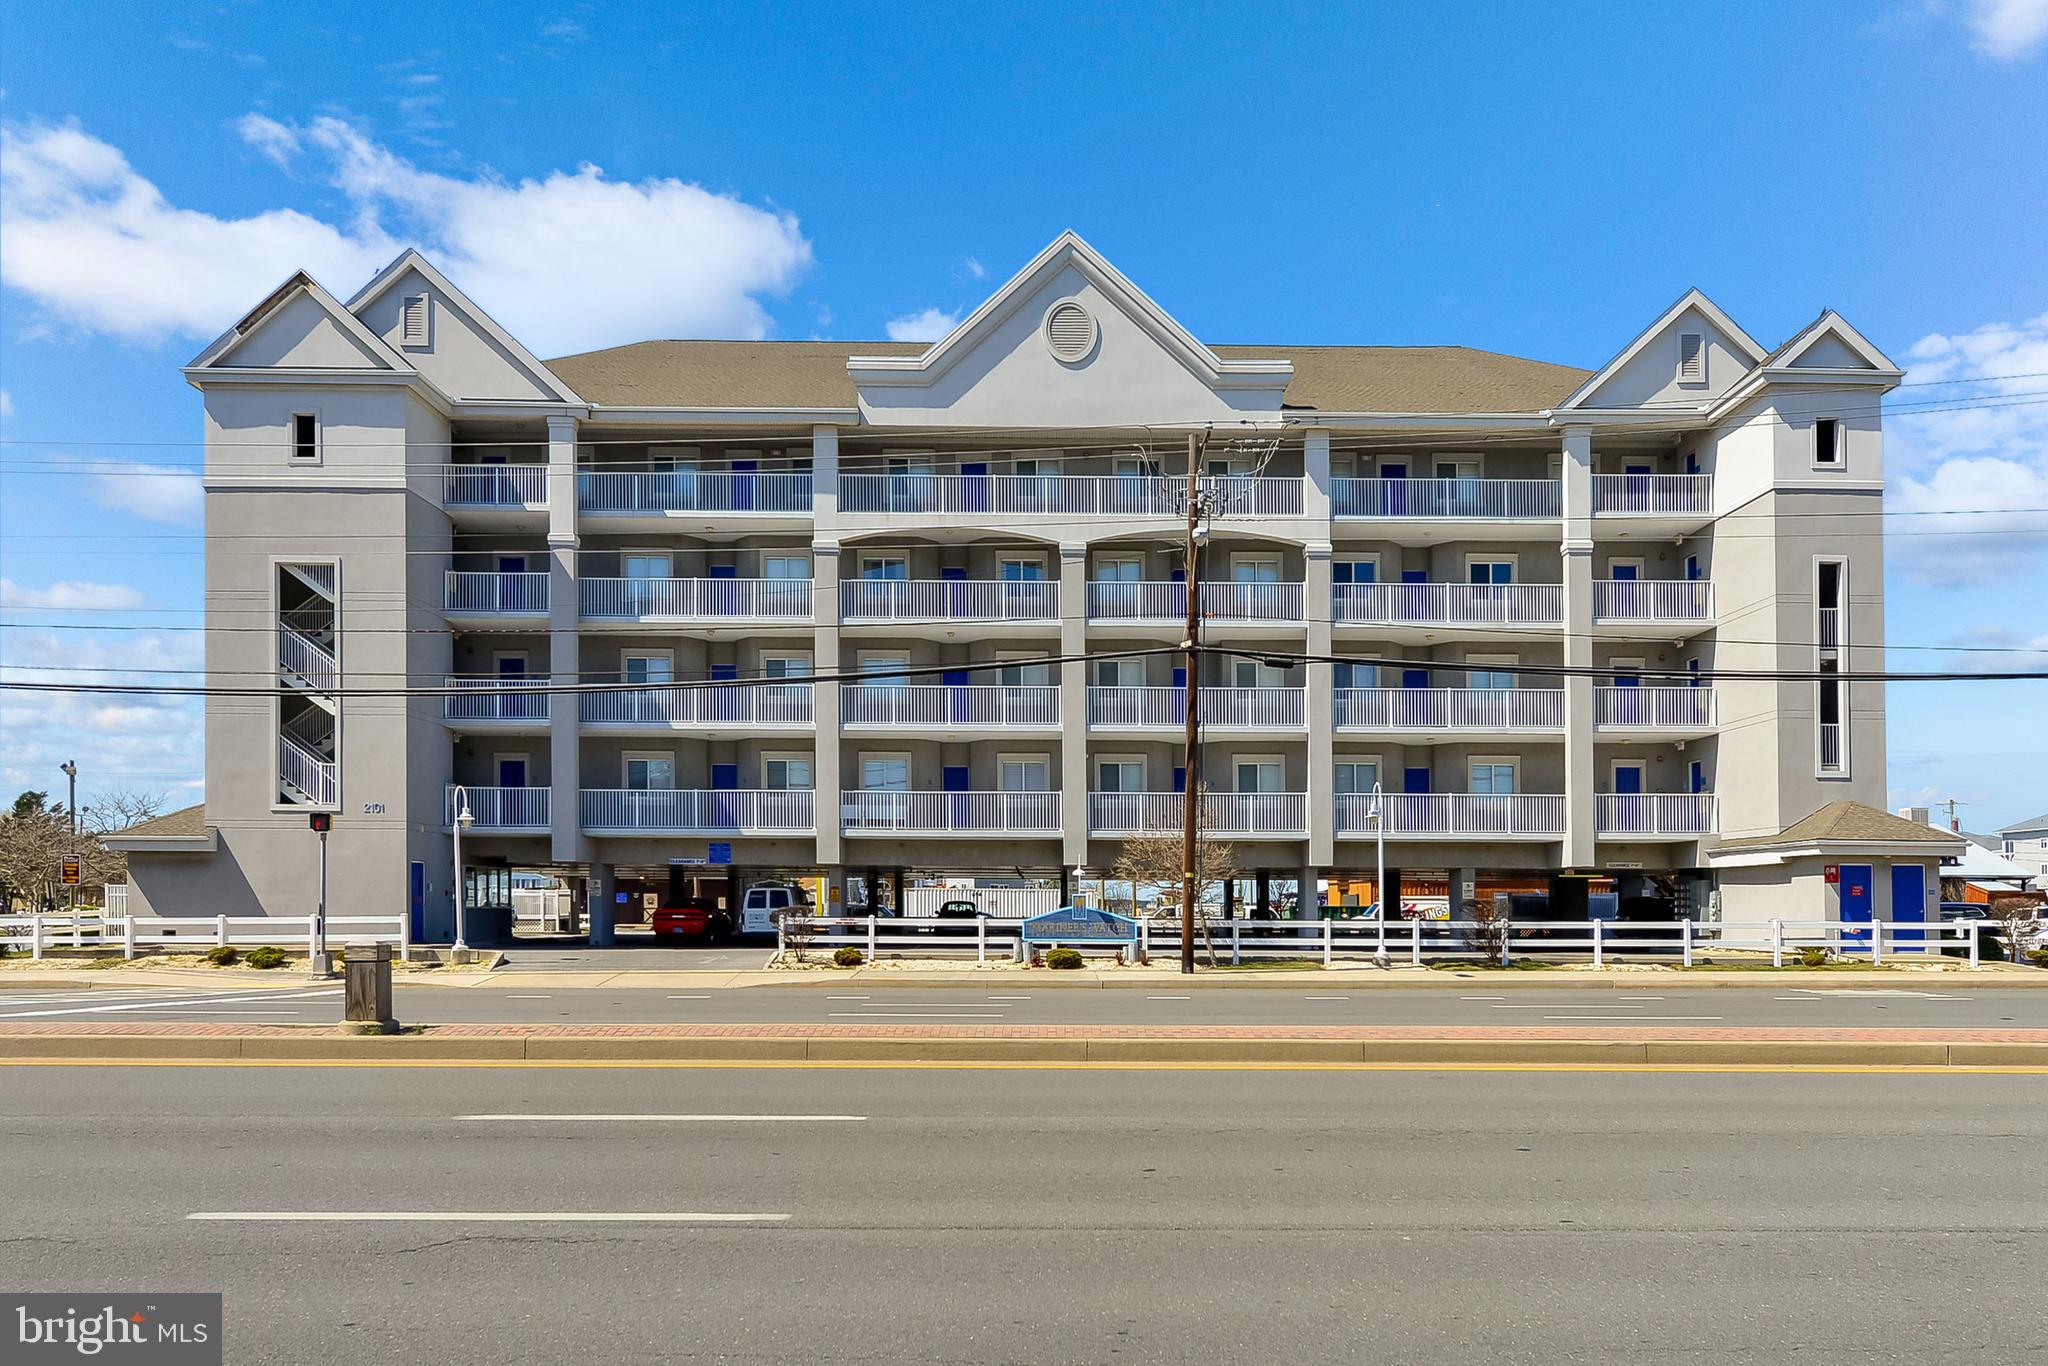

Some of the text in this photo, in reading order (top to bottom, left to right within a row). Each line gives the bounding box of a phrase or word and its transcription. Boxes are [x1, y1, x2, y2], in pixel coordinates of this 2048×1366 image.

[364, 803, 386, 814] 2101
[1420, 905, 1449, 920] INGS
[1089, 922, 1128, 933] WATCH
